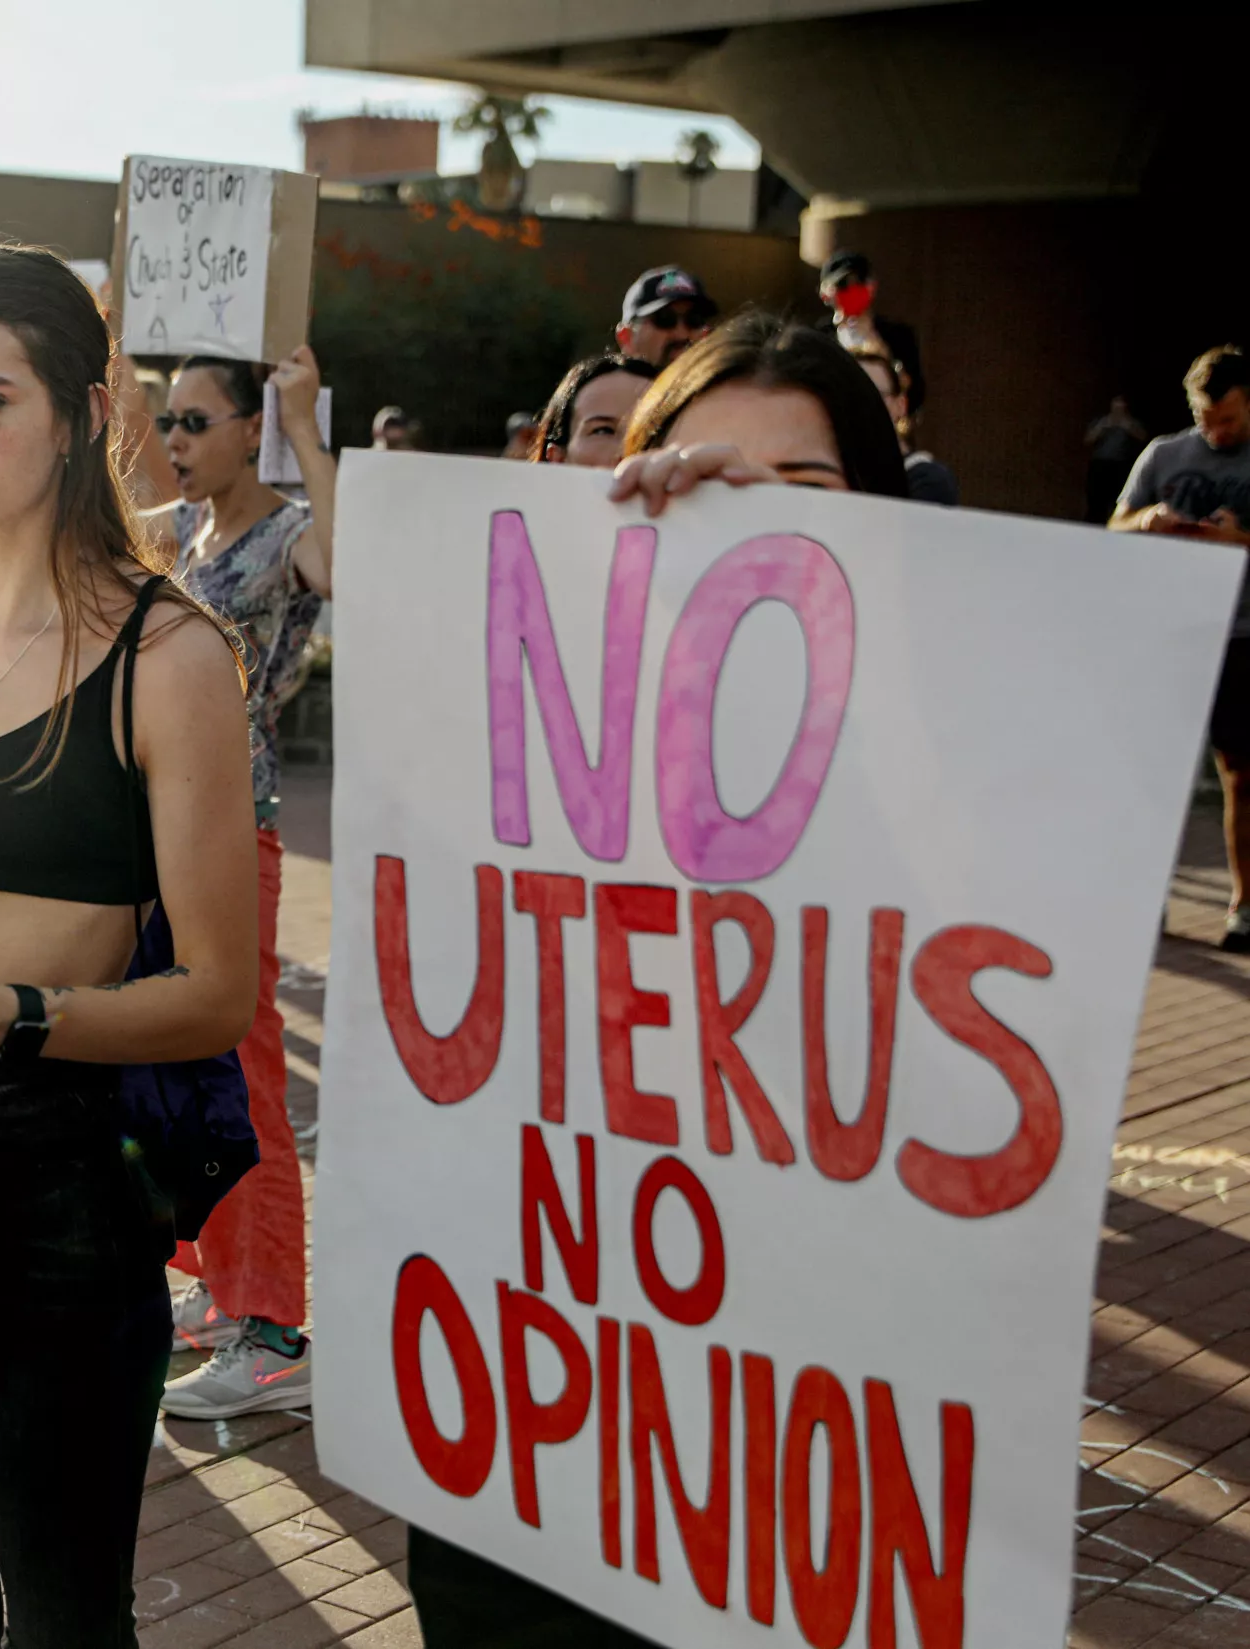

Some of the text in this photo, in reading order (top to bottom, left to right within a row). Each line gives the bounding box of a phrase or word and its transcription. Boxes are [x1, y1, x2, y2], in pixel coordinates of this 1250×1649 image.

[132, 159, 246, 207] Separation
[197, 237, 249, 291] State
[486, 508, 855, 883] NO
[373, 854, 1064, 1218] UTERUS
[520, 1122, 725, 1326] NO
[391, 1252, 975, 1649] OPINION
